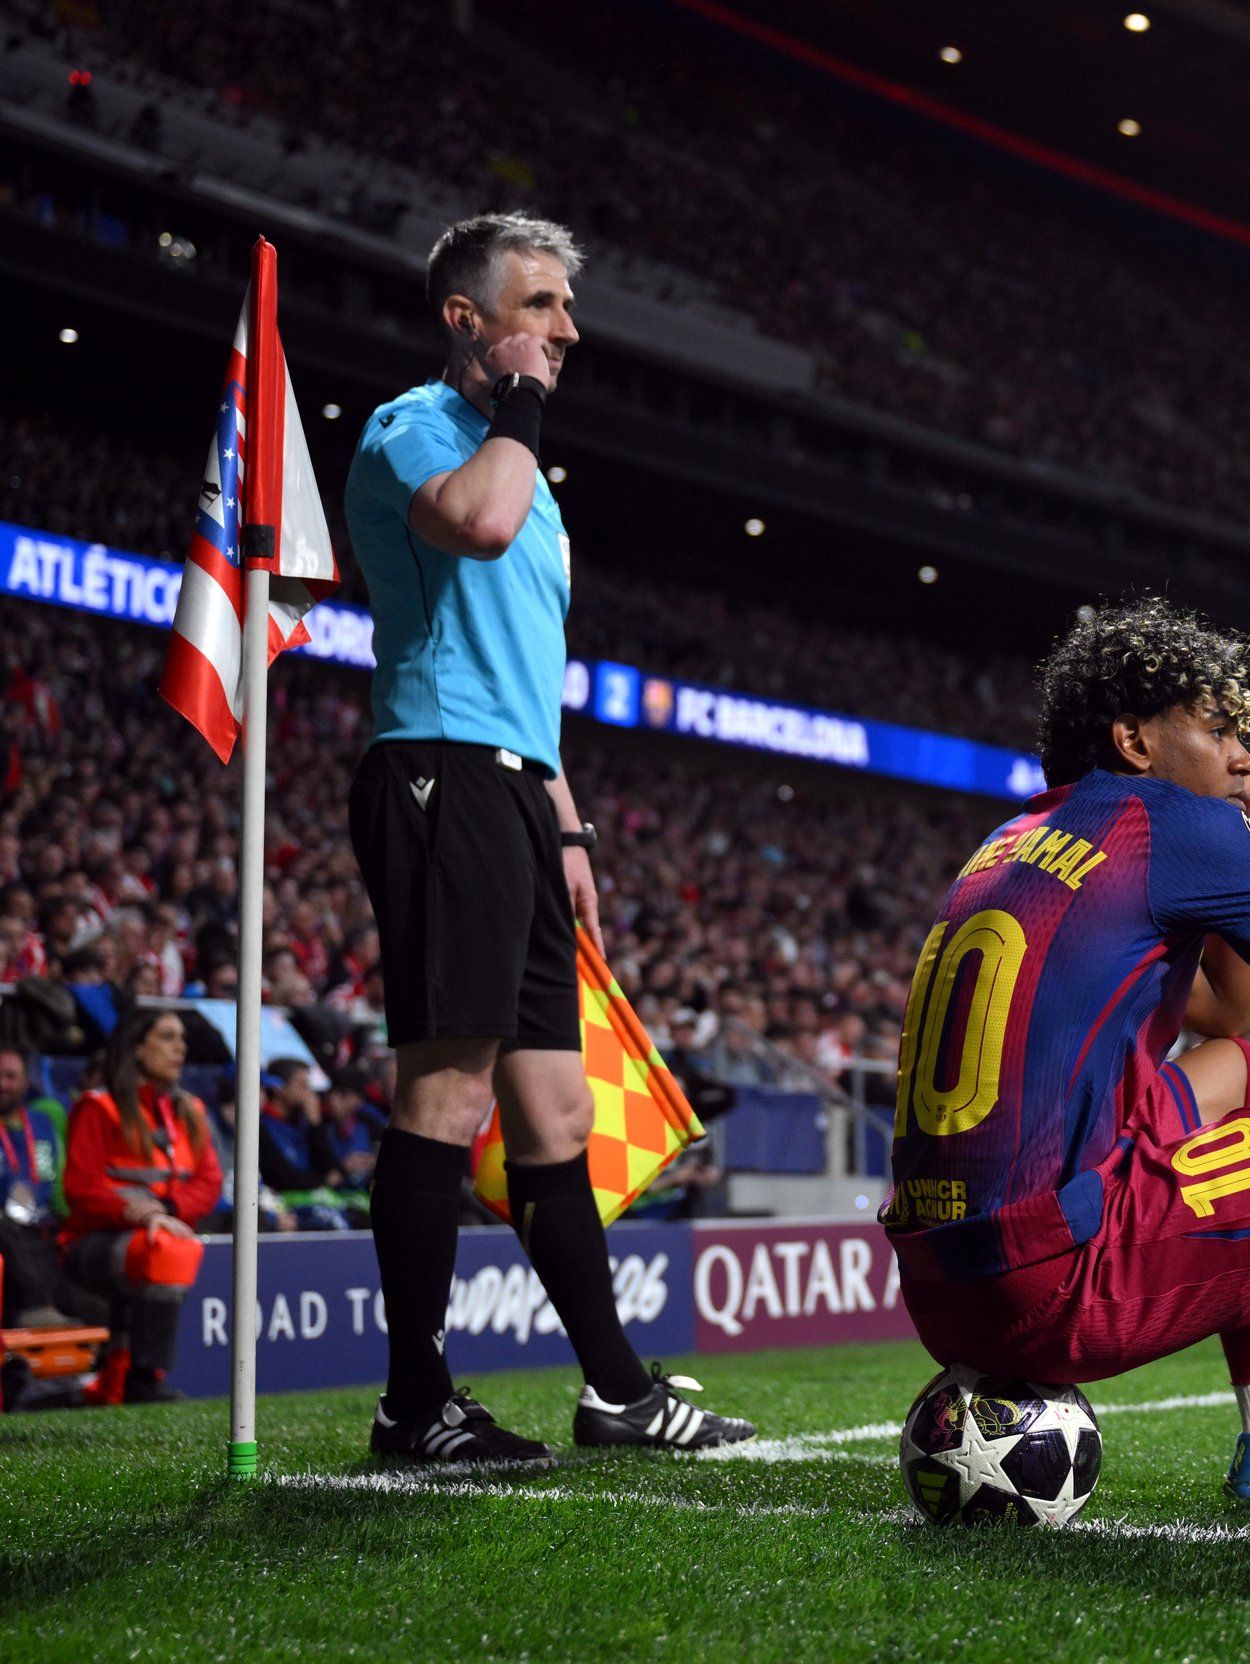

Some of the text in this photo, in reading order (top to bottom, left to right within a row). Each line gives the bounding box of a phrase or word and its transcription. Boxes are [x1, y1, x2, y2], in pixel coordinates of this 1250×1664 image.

[676, 686, 869, 767] FC BARCELONA
[893, 909, 1028, 1137] 10
[202, 1293, 328, 1347] RAD
[694, 1238, 876, 1336] QATAR
